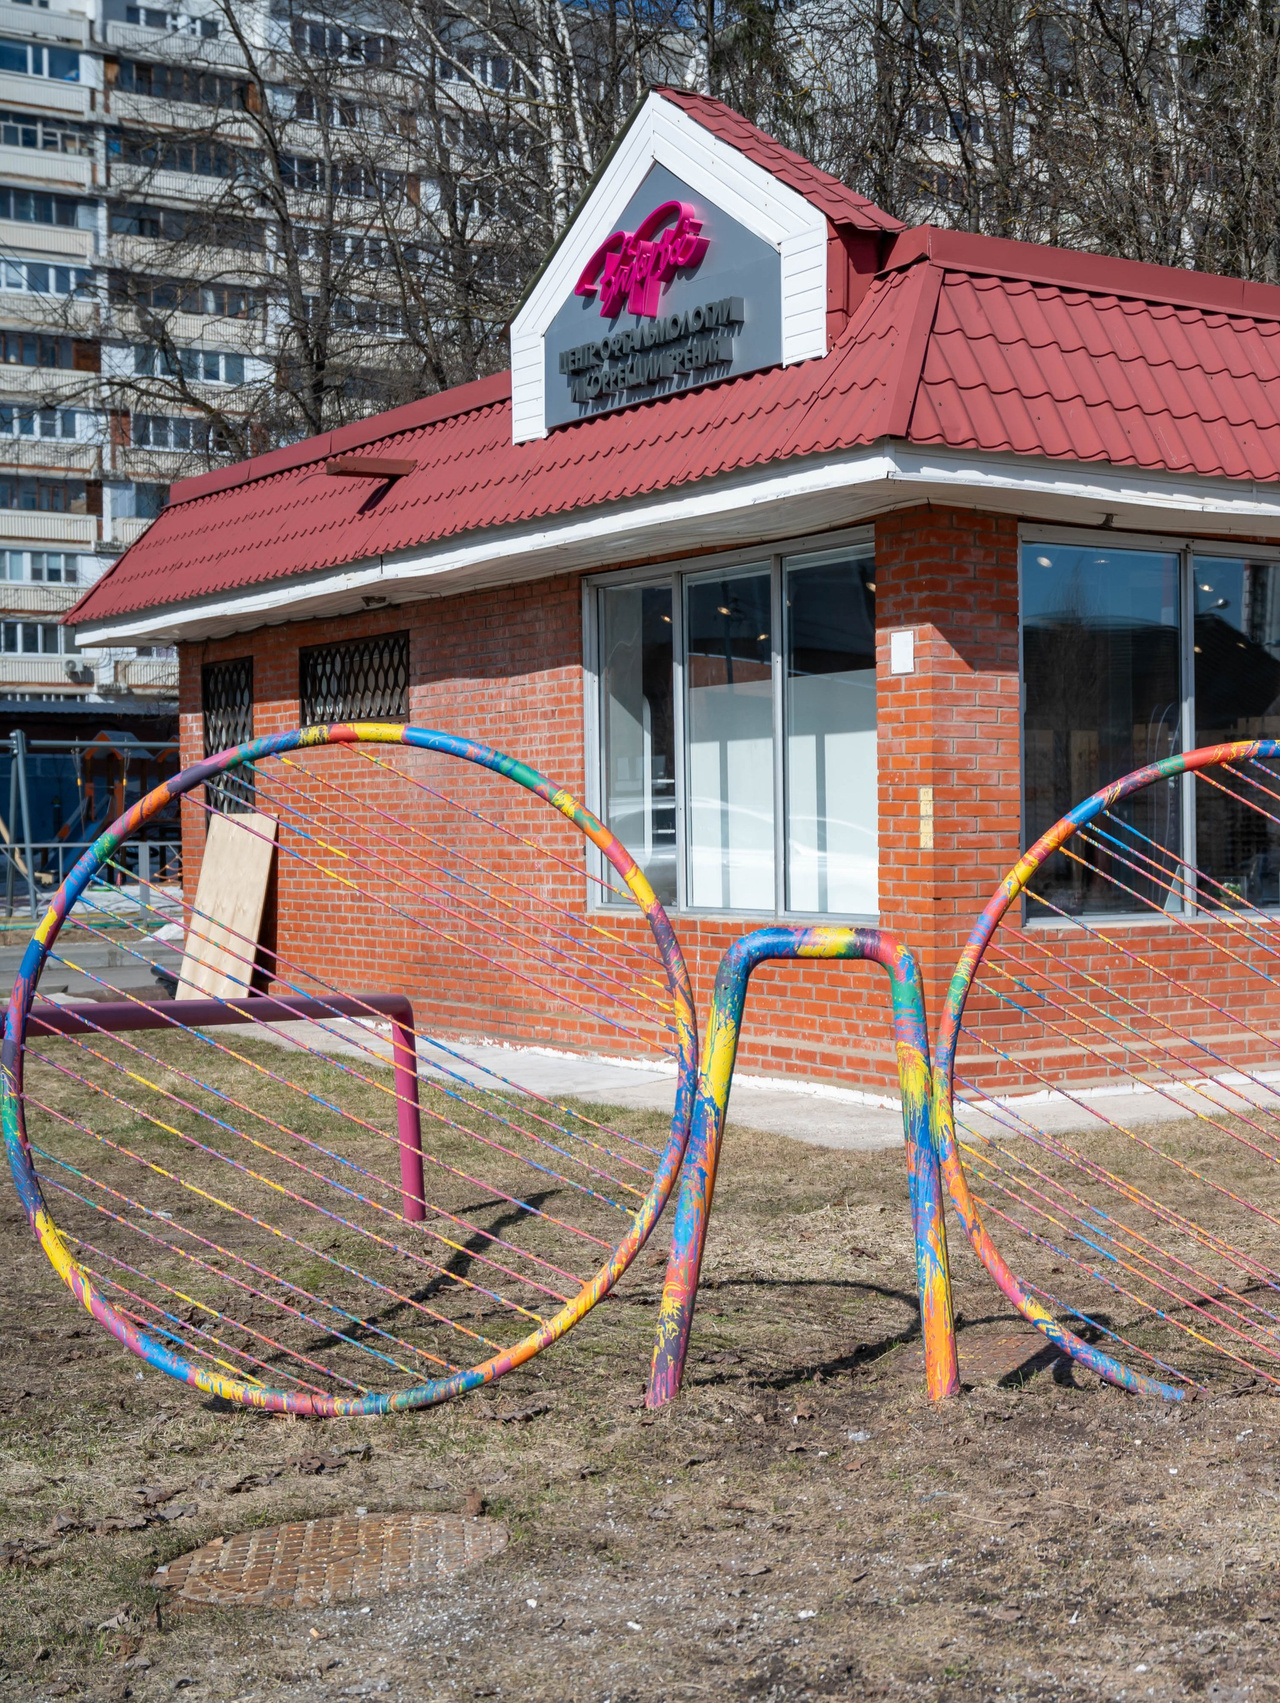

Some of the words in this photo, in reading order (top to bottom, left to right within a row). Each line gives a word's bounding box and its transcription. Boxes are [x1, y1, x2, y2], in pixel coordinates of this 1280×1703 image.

[559, 342, 601, 374] ЦЕНТР
[600, 296, 745, 360] ОФТАЛЬМОЛОГИИ
[571, 378, 584, 403] И
[583, 354, 669, 399] КОРРЕКЦИИ
[669, 337, 733, 374] ЗРЕНИЯ
